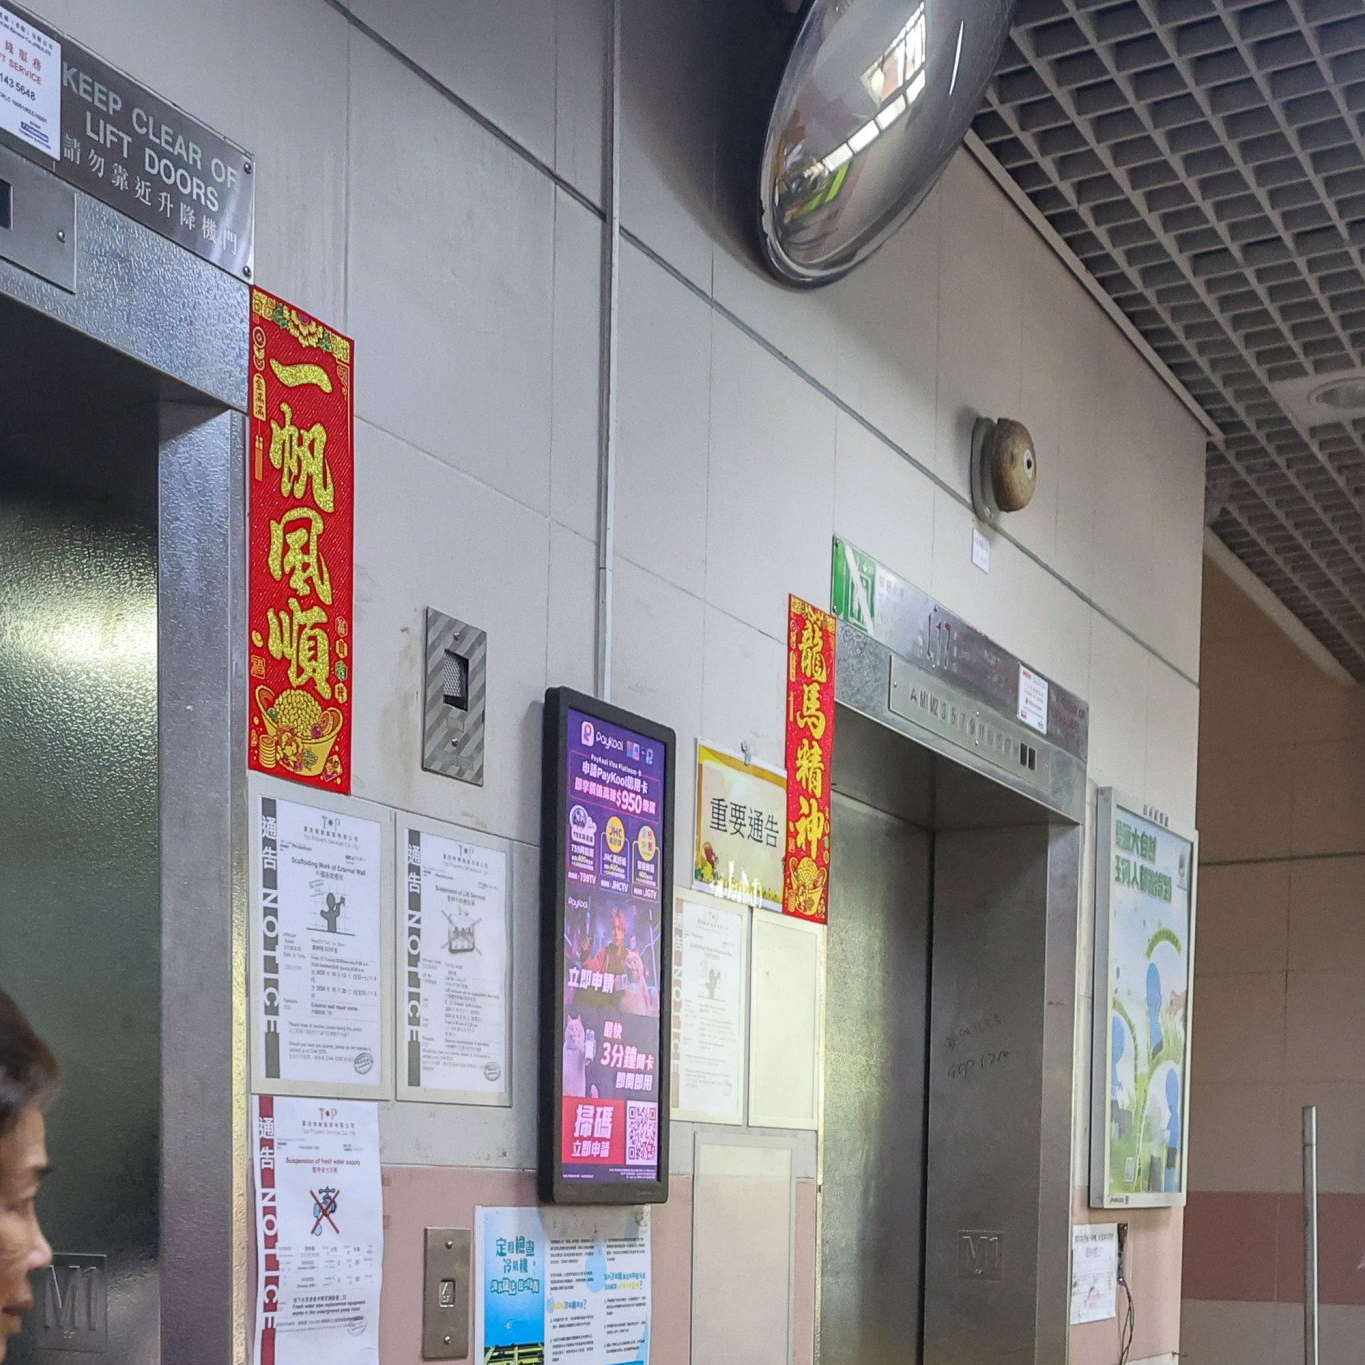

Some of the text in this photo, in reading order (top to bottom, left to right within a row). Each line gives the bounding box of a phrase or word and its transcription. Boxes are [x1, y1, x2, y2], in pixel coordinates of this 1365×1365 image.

[9, 59, 42, 86] SERVICE
[15, 81, 36, 102] 5648
[62, 61, 123, 115] KEEP
[131, 107, 203, 171] CLEAR
[210, 157, 239, 188] OF
[85, 110, 133, 159] LIFT
[144, 146, 220, 213] DOORS
[63, 132, 238, 256] 請勿靠近升降機門
[267, 356, 335, 702] 一帆風順
[795, 619, 828, 860] 龍馬精神
[262, 814, 277, 871] 通告
[709, 797, 780, 849] 重要通告
[408, 844, 421, 894] 通告
[262, 887, 280, 1034] NOTICE
[408, 910, 421, 1042] NOTICE
[567, 966, 615, 995] 立即申請
[600, 1042, 654, 1072] 3分鐘開卡
[603, 1021, 622, 1041] 最快
[259, 1116, 274, 1170] 通告
[573, 1104, 614, 1140] 掃碼
[285, 1156, 314, 1165] Suspension
[346, 1159, 361, 1167] supply
[571, 1140, 610, 1158] 立即申請
[261, 1187, 279, 1329] NOTICE
